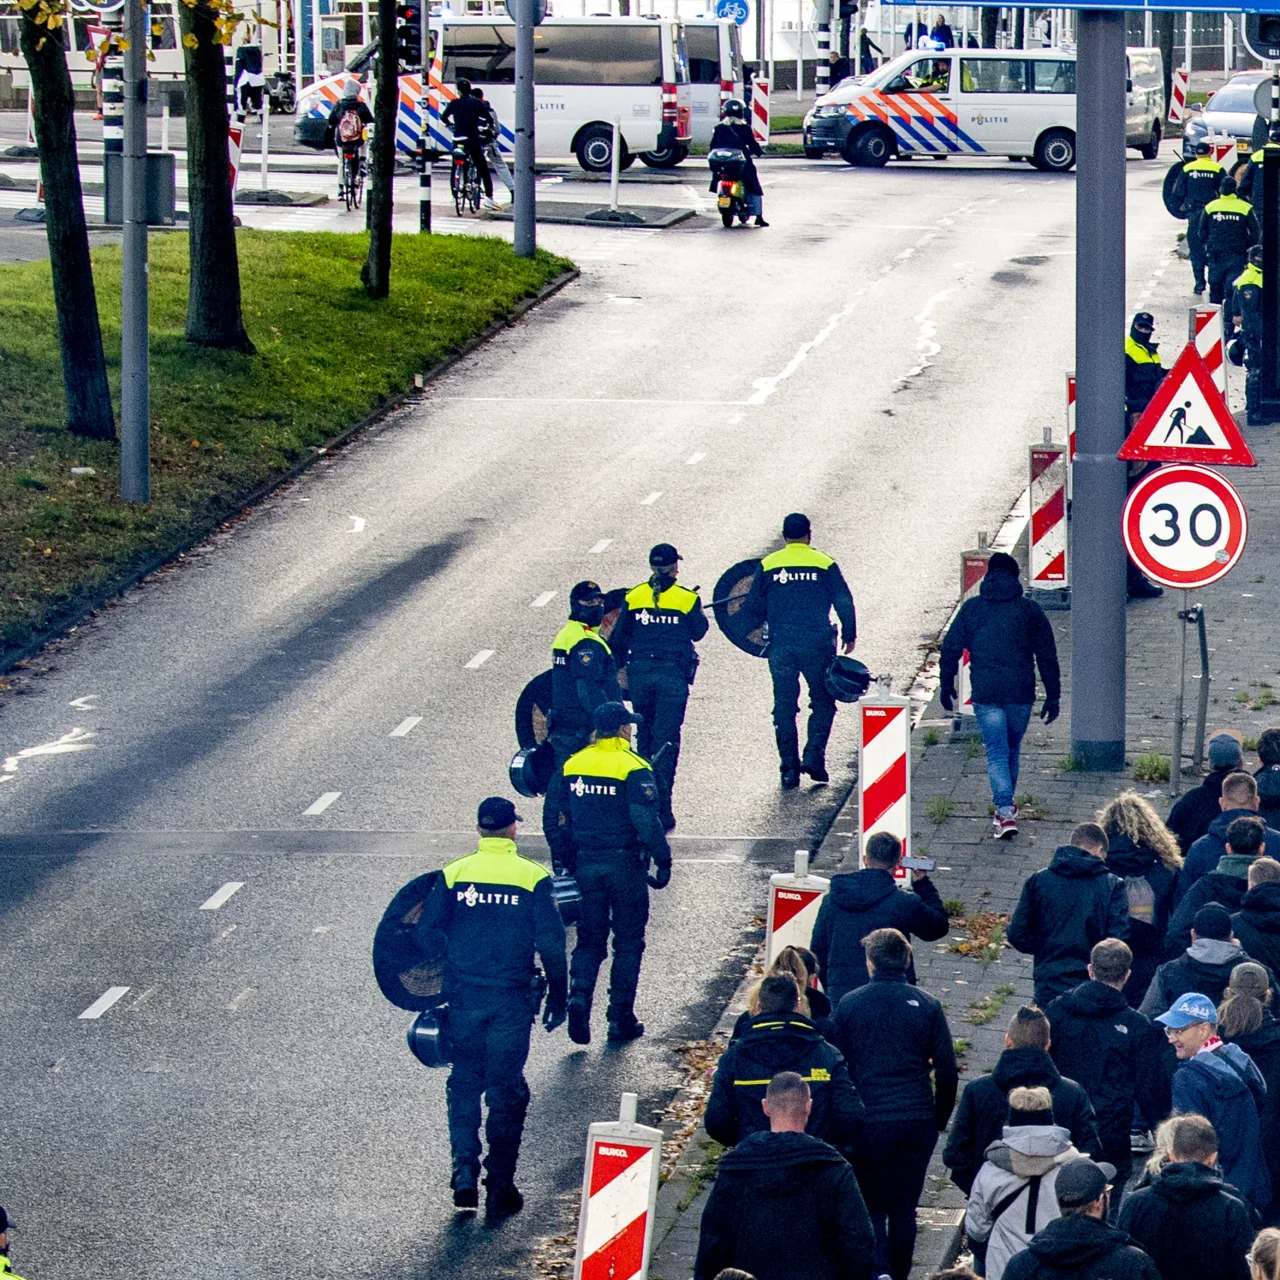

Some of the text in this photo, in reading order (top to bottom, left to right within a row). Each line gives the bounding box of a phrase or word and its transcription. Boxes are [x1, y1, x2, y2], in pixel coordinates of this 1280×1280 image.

[971, 114, 1008, 124] POLITIE
[1148, 502, 1222, 547] 30
[772, 570, 818, 582] POLITIE
[635, 611, 679, 625] POLITIE
[570, 779, 617, 796] POLITIE
[457, 888, 519, 906] POLITIE
[598, 1146, 628, 1158] BUKO.
